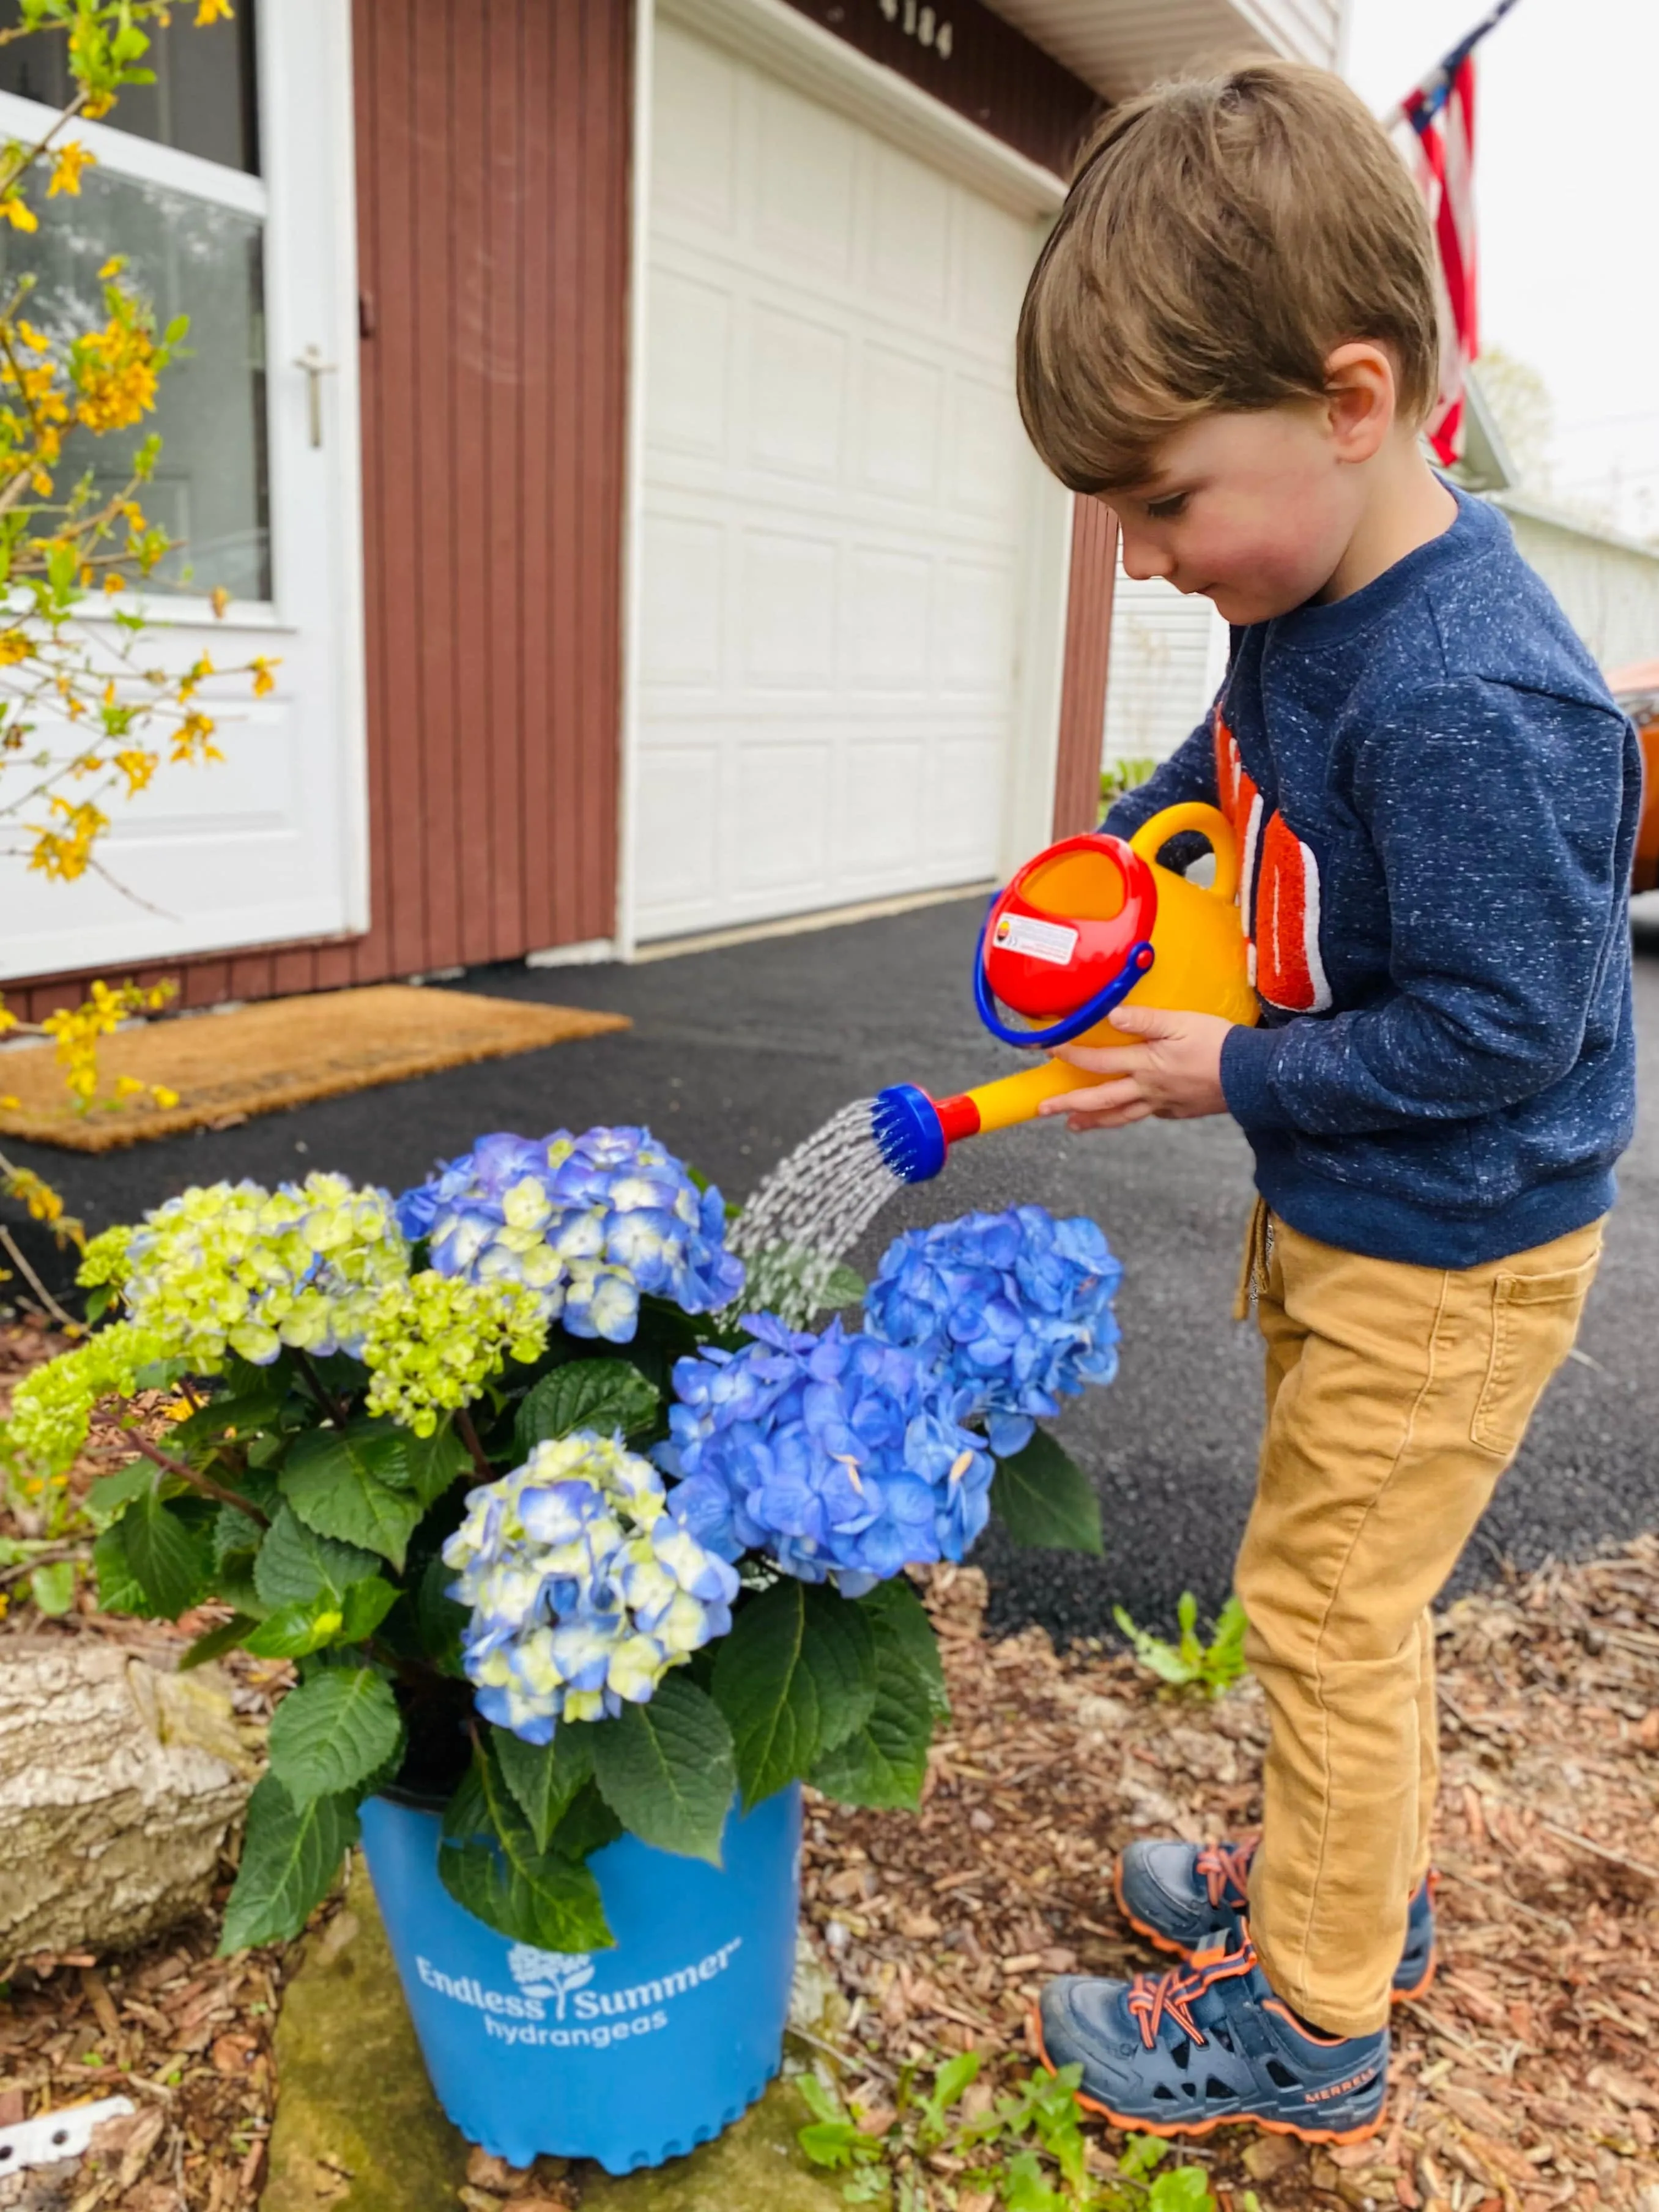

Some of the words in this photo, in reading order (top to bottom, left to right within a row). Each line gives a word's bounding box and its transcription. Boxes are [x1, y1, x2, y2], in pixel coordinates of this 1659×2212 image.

[416, 1954, 546, 2021] Endless
[484, 2010, 669, 2048] hydrangeas
[1304, 2067, 1376, 2104] MERRELL
